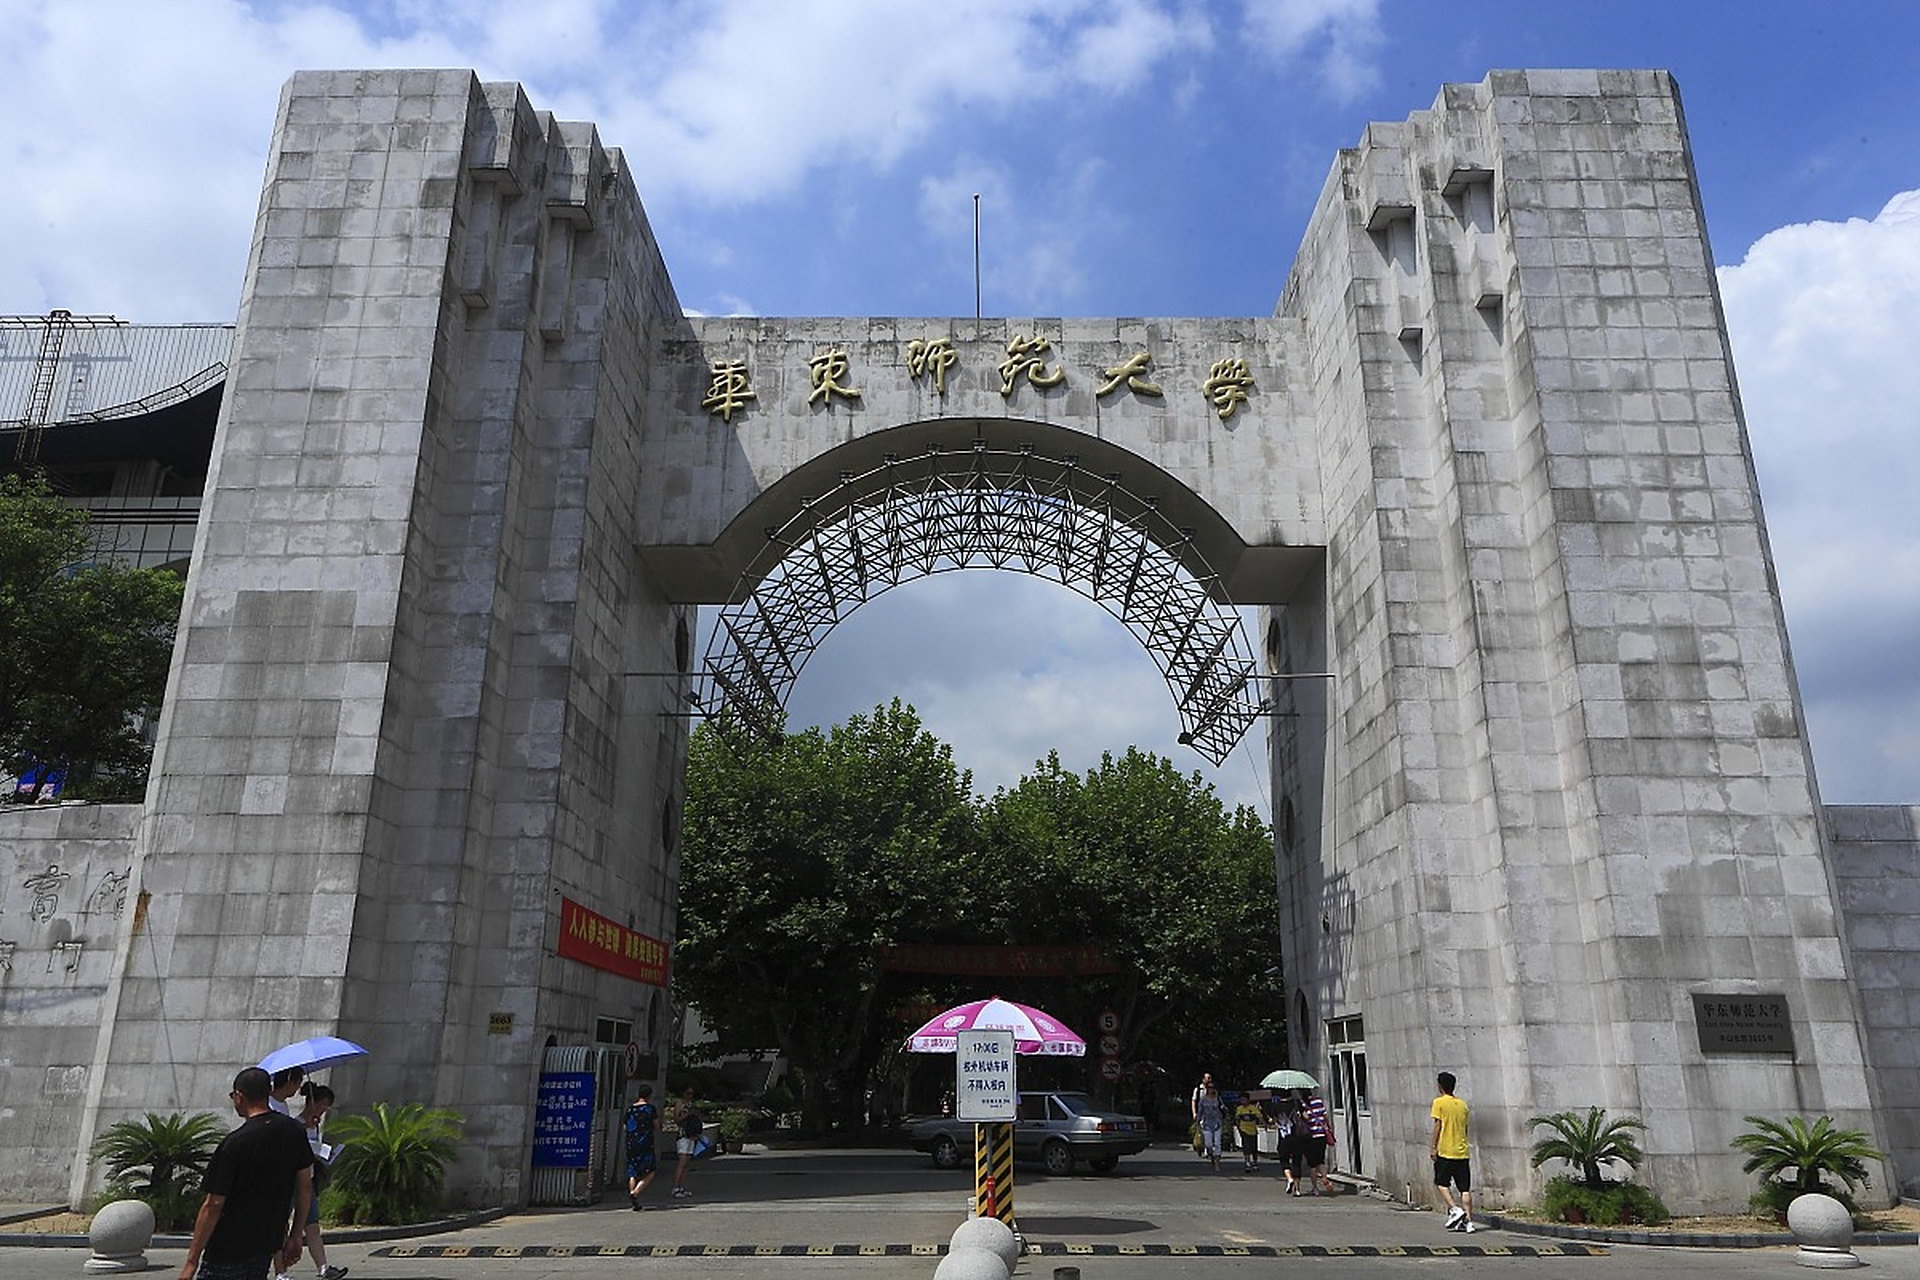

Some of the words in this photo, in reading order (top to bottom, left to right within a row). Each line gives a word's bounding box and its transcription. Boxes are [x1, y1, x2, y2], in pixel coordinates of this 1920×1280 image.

[1703, 1003, 1780, 1017] 华东师范大学
[1105, 1016, 1113, 1028] 5
[963, 1060, 1009, 1073] 校外机动车辆
[967, 1079, 1006, 1091] 不得入校内
